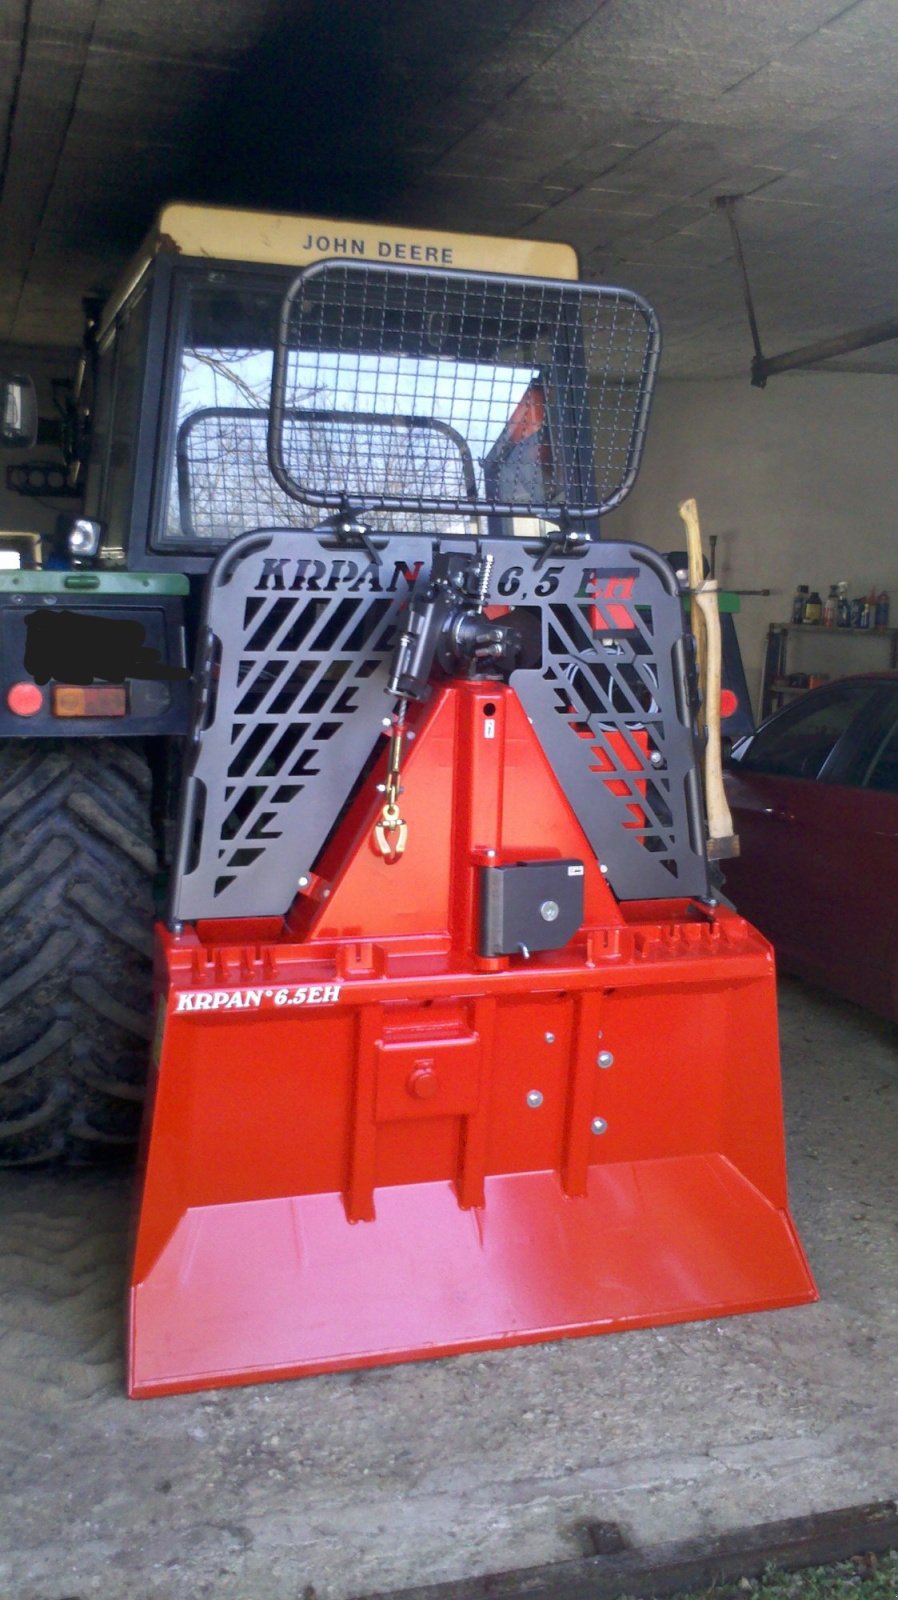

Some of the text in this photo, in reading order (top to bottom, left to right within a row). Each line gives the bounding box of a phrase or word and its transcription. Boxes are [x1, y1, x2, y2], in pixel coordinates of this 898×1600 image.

[303, 234, 453, 263] JOHN DEERE
[254, 558, 424, 592] KRPAN
[497, 566, 565, 600] 6,5
[274, 986, 341, 1005] 6.5EH
